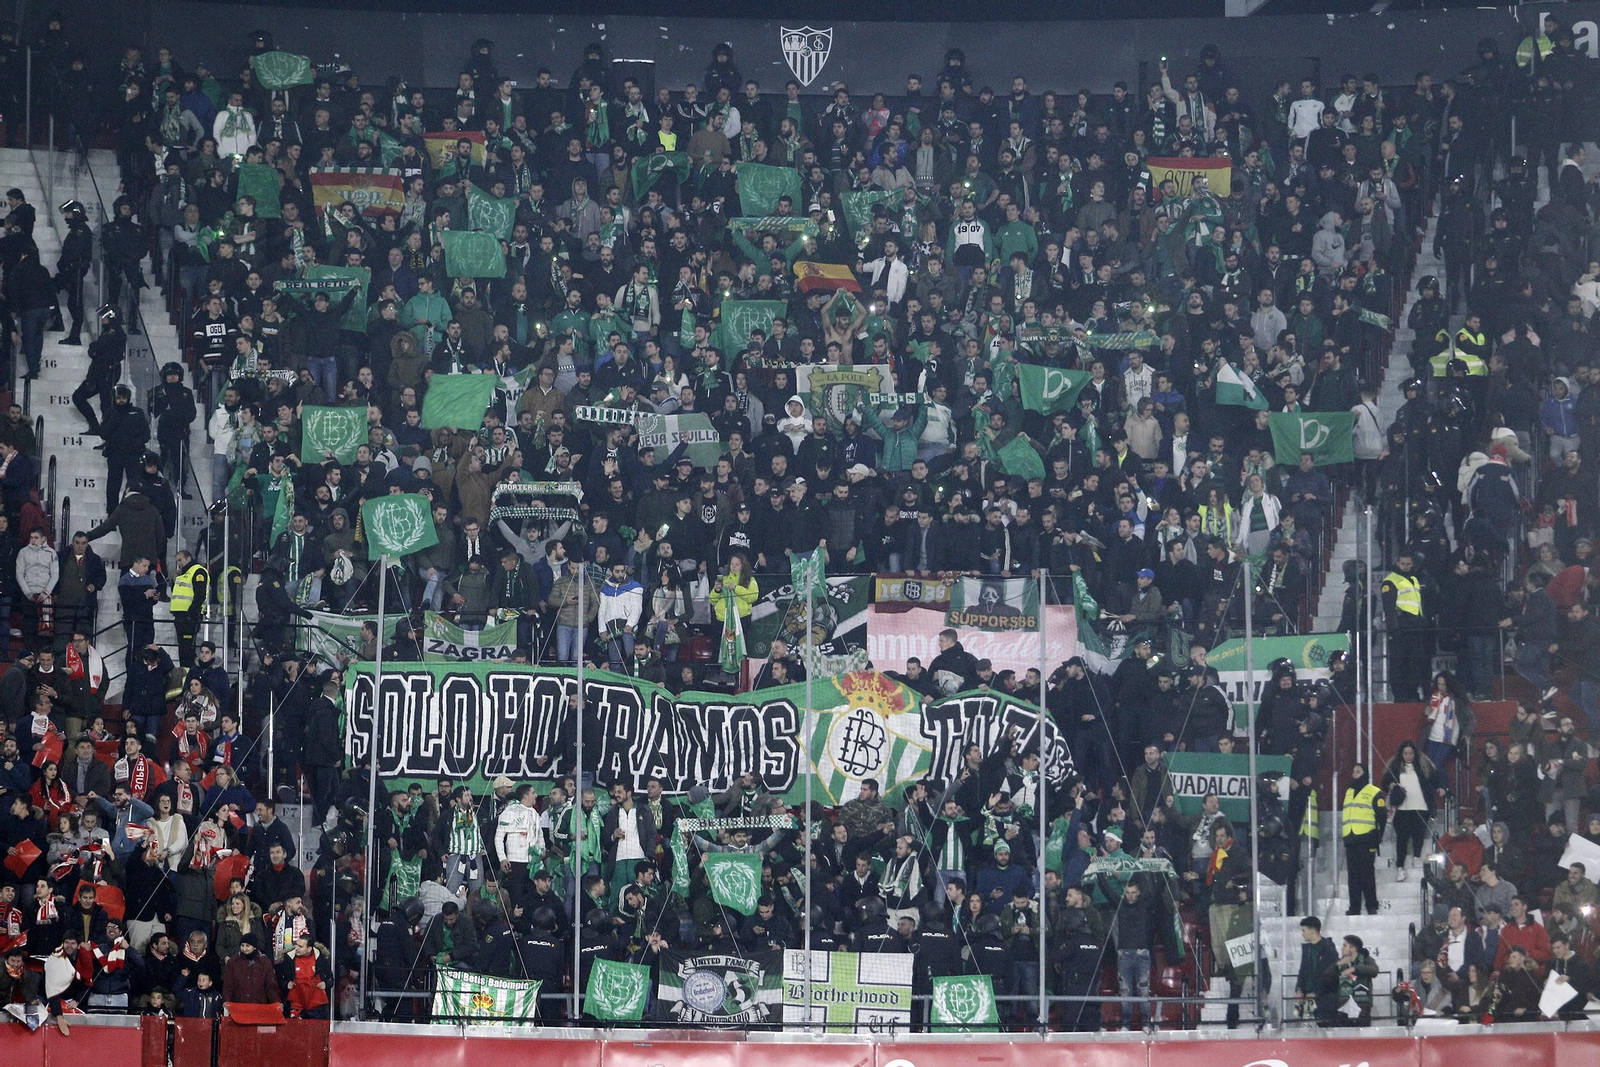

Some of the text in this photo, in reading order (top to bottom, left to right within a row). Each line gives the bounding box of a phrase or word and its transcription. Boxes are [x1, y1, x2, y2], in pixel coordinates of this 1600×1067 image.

[41, 359, 57, 369] 16
[827, 374, 837, 383] LA
[842, 374, 864, 383] POLE
[870, 393, 916, 404] BETIS
[63, 436, 83, 446] F14
[91, 519, 108, 529] F1
[427, 639, 514, 660] ZAGRA
[350, 671, 483, 780] SOLO
[482, 672, 800, 795] HORAMOS
[1172, 775, 1251, 797] UADALCA
[692, 957, 721, 967] UNITED
[463, 972, 486, 986] Betis
